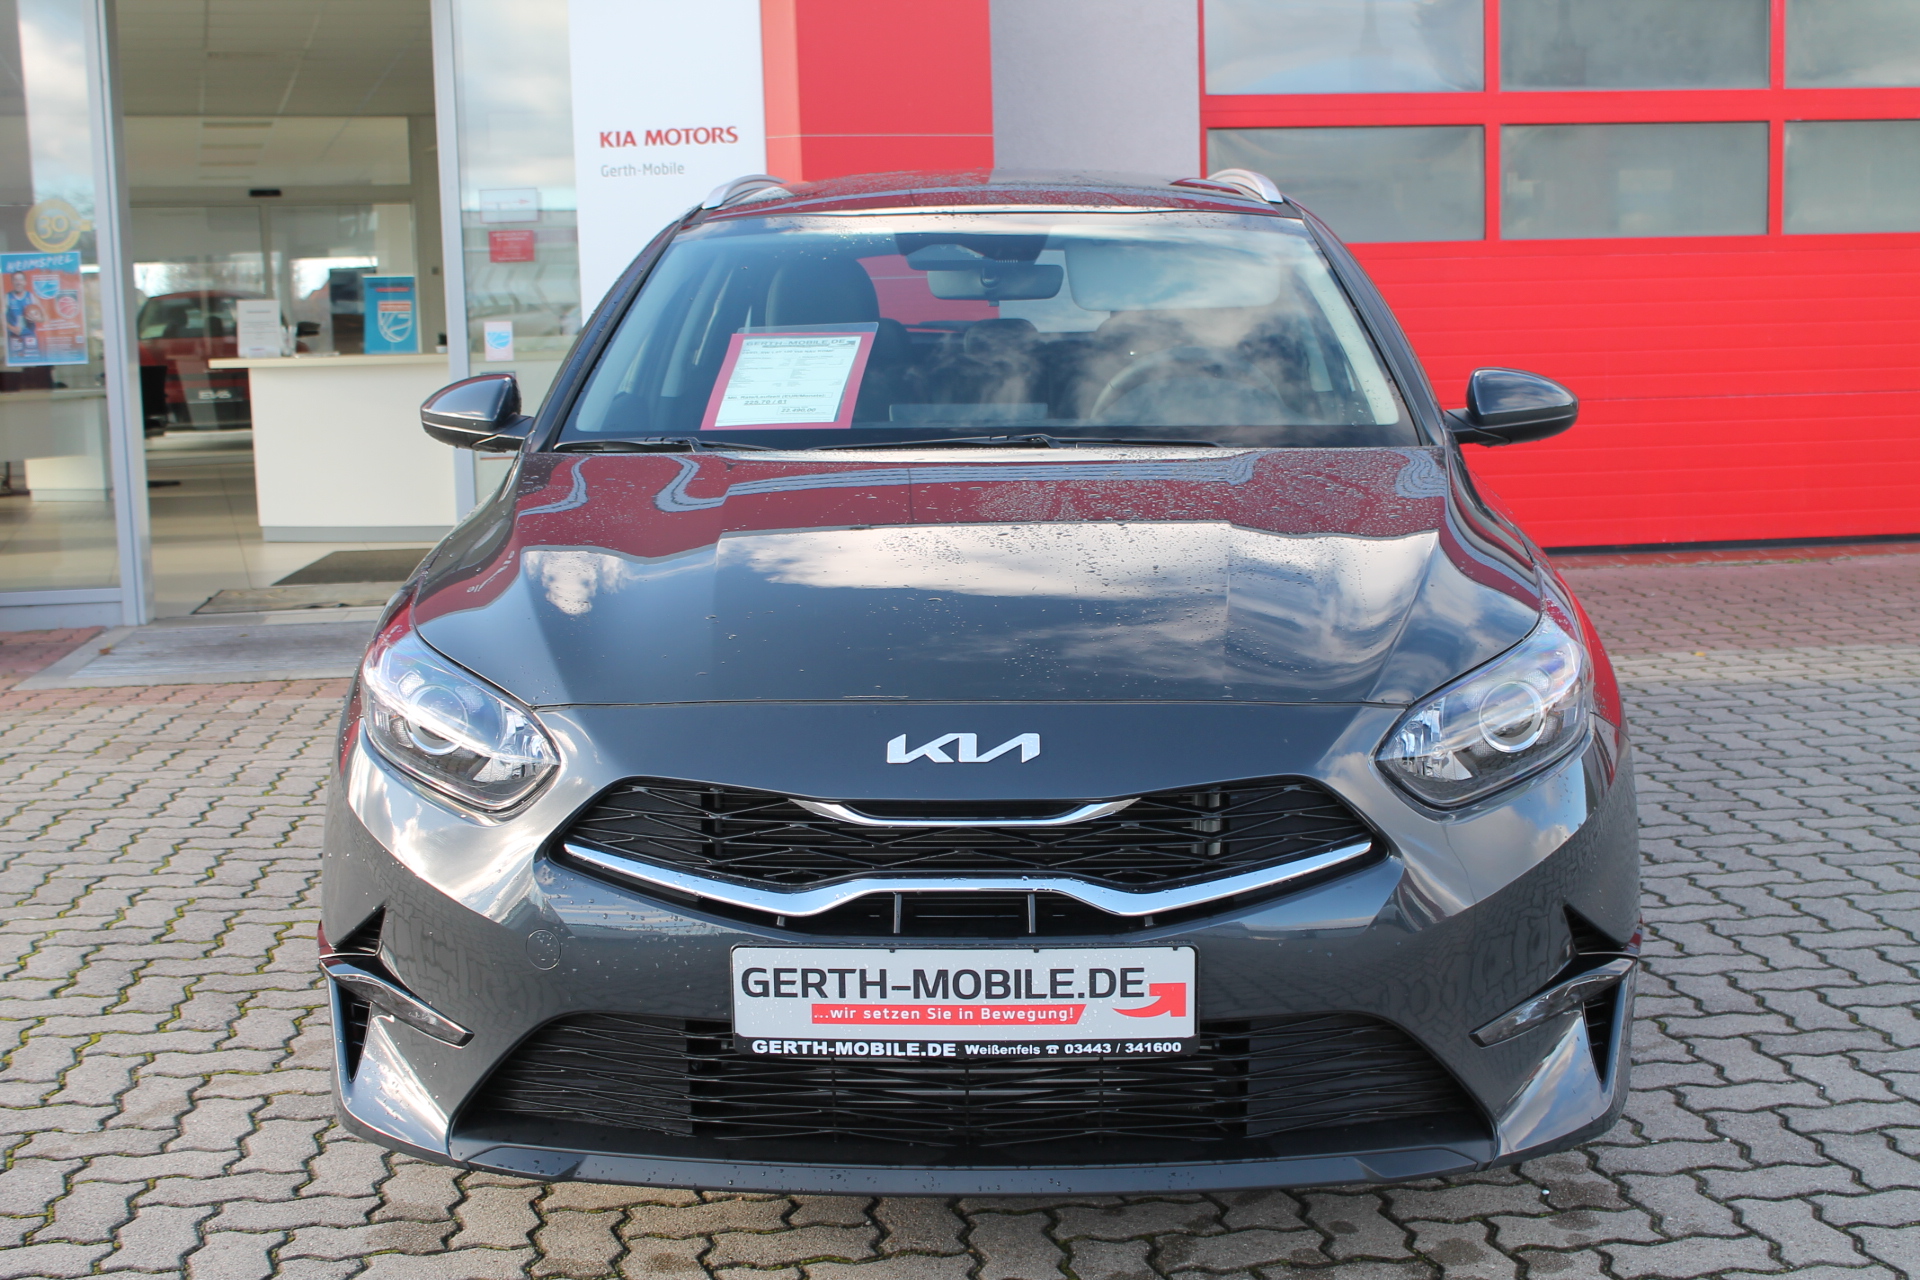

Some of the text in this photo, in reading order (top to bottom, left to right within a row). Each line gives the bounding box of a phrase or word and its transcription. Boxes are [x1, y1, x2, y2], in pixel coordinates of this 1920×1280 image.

[600, 126, 739, 148] KIA MOTORS
[600, 162, 685, 178] Gerth-Mobile
[40, 215, 69, 239] 30
[886, 732, 1041, 764] KIA
[741, 966, 1146, 1000] GERTH-MOBILE.DE
[813, 1006, 1075, 1022] ...wir setzen Sie in Bewegung!
[751, 1039, 1182, 1057] GERTH-MOBILE.DE Weißenfels 03443 / 341600
